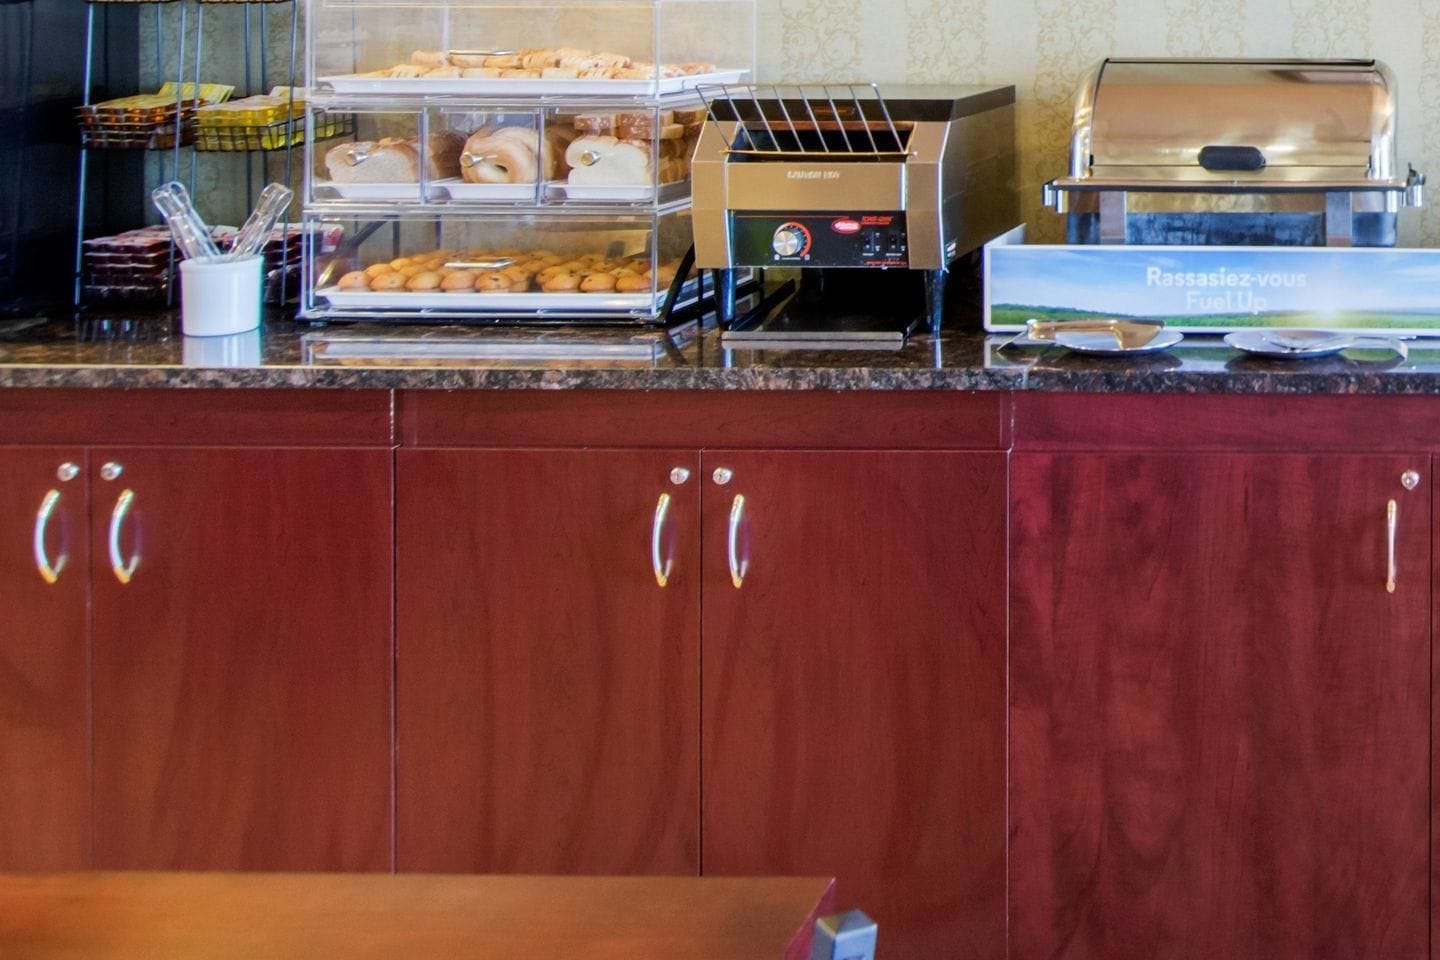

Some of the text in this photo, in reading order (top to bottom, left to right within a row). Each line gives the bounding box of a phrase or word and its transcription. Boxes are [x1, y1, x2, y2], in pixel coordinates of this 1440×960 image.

[1146, 266, 1307, 288] Rassasiez-vous
[1186, 290, 1268, 315] Fuel Up
